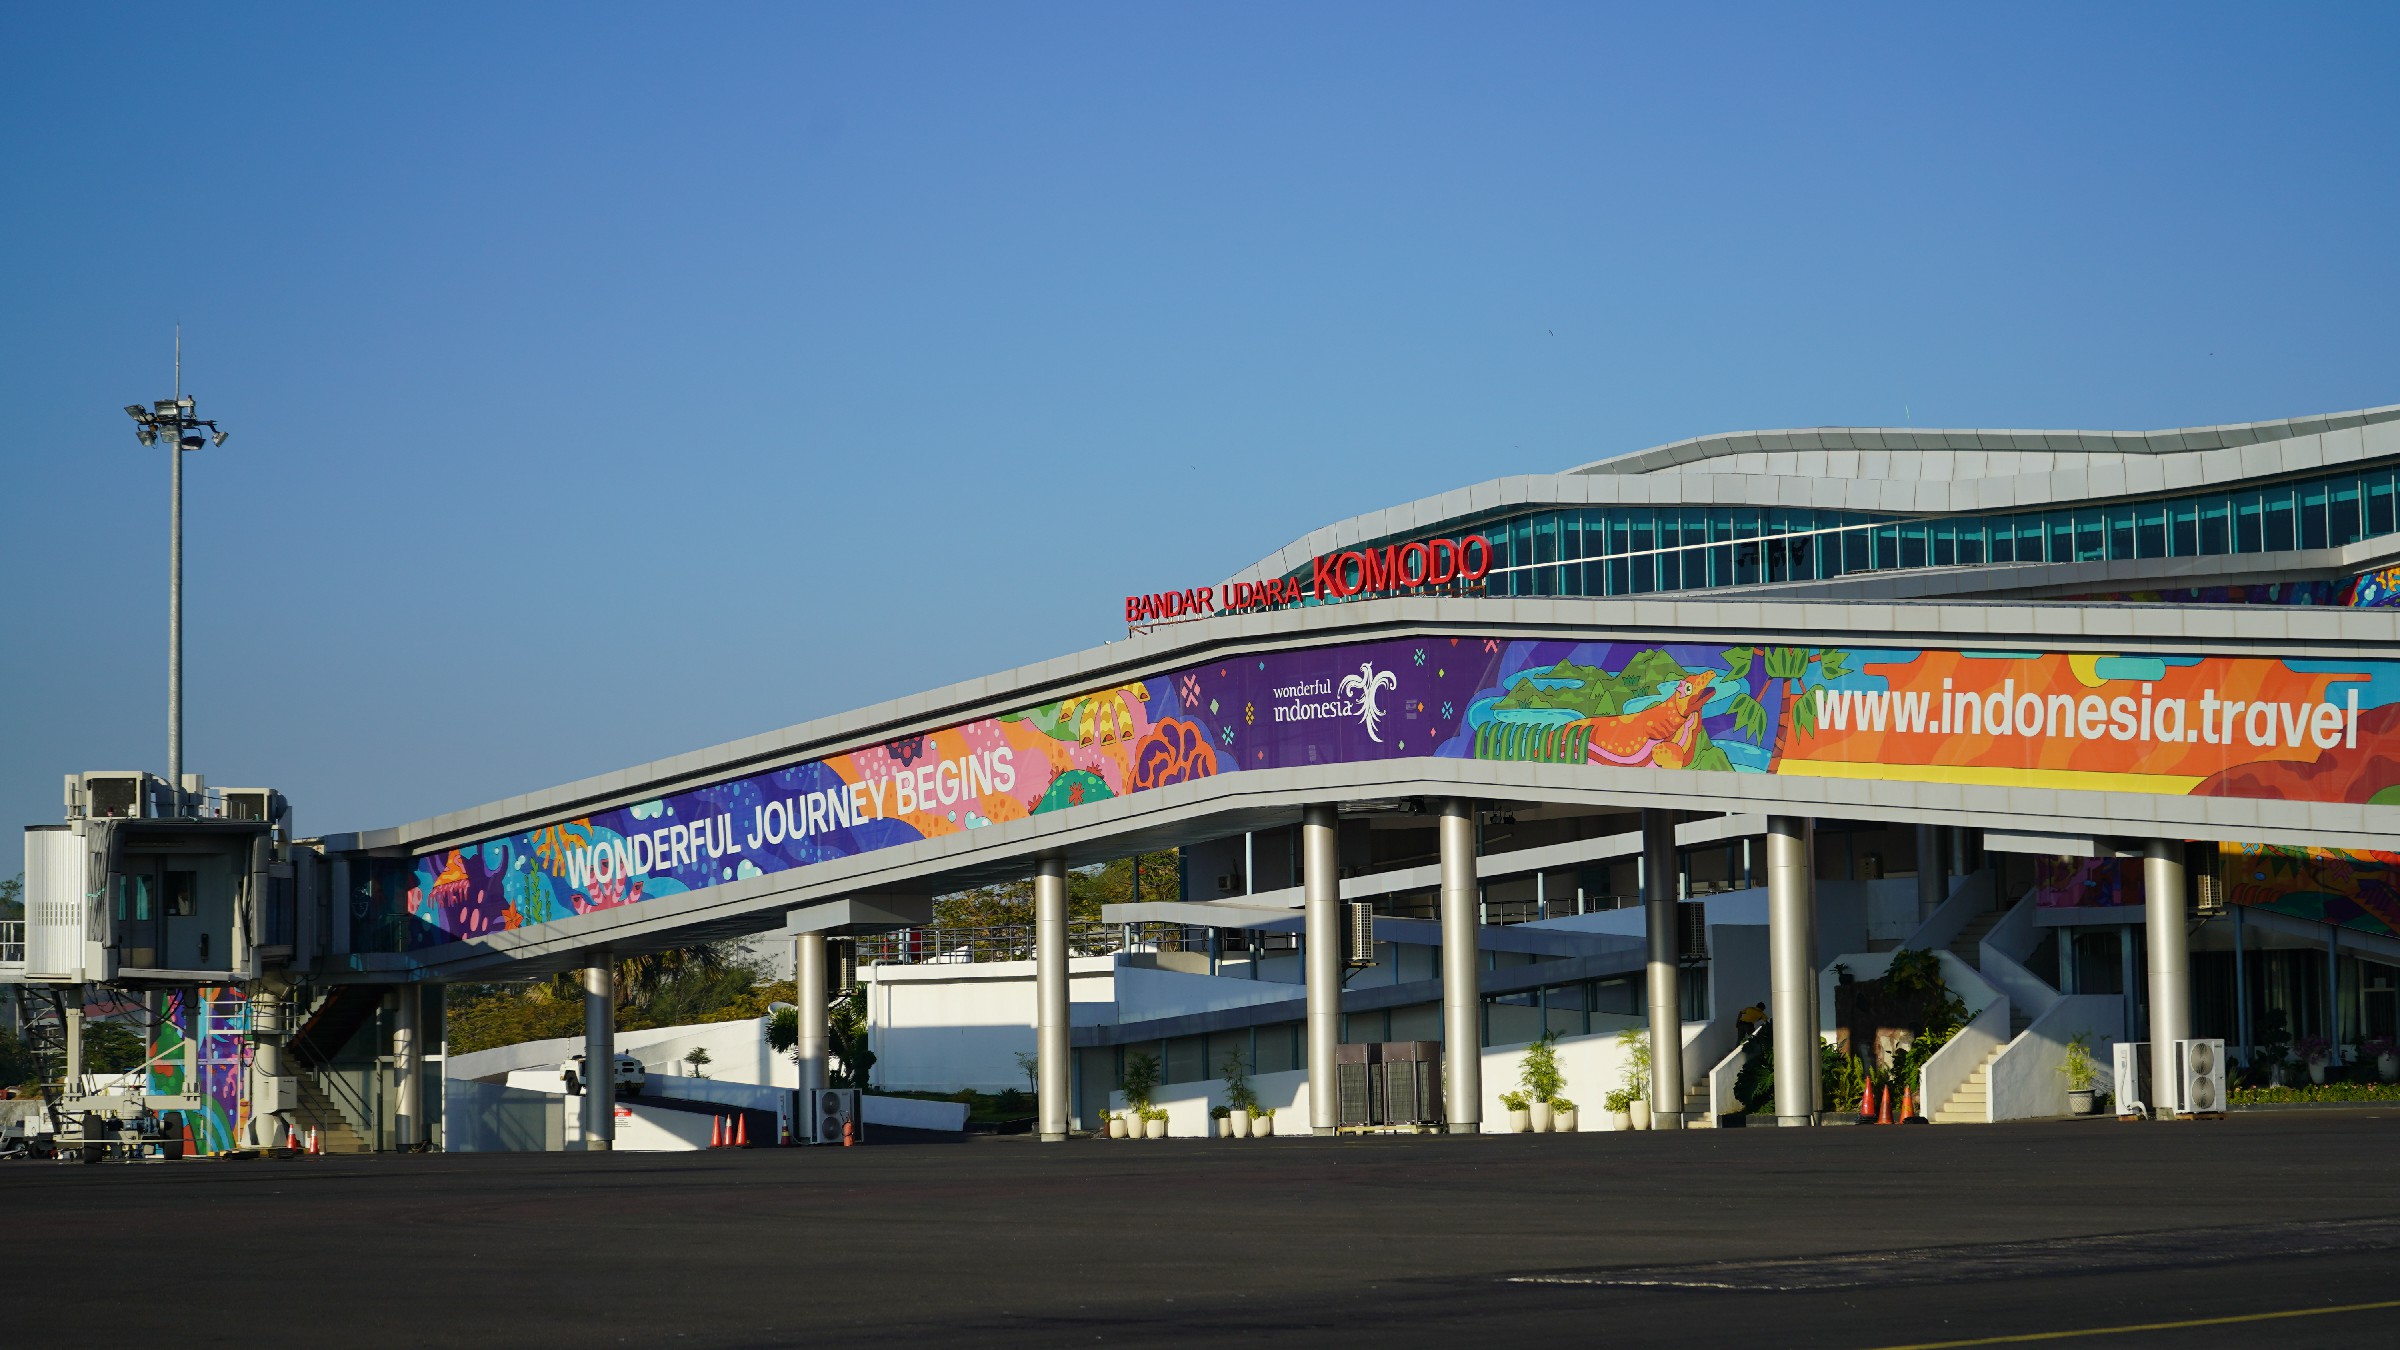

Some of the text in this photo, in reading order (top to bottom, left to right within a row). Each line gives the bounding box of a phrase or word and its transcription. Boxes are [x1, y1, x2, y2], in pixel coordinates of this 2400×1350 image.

[1125, 535, 1494, 622] BANDAR UDARA KOMODO
[1273, 679, 1331, 698] wonderful
[1274, 699, 1354, 722] indonesia
[1815, 678, 2358, 749] www.indonesia.travel
[566, 747, 1016, 889] WONDERFUL JOURNEY BEGINS
